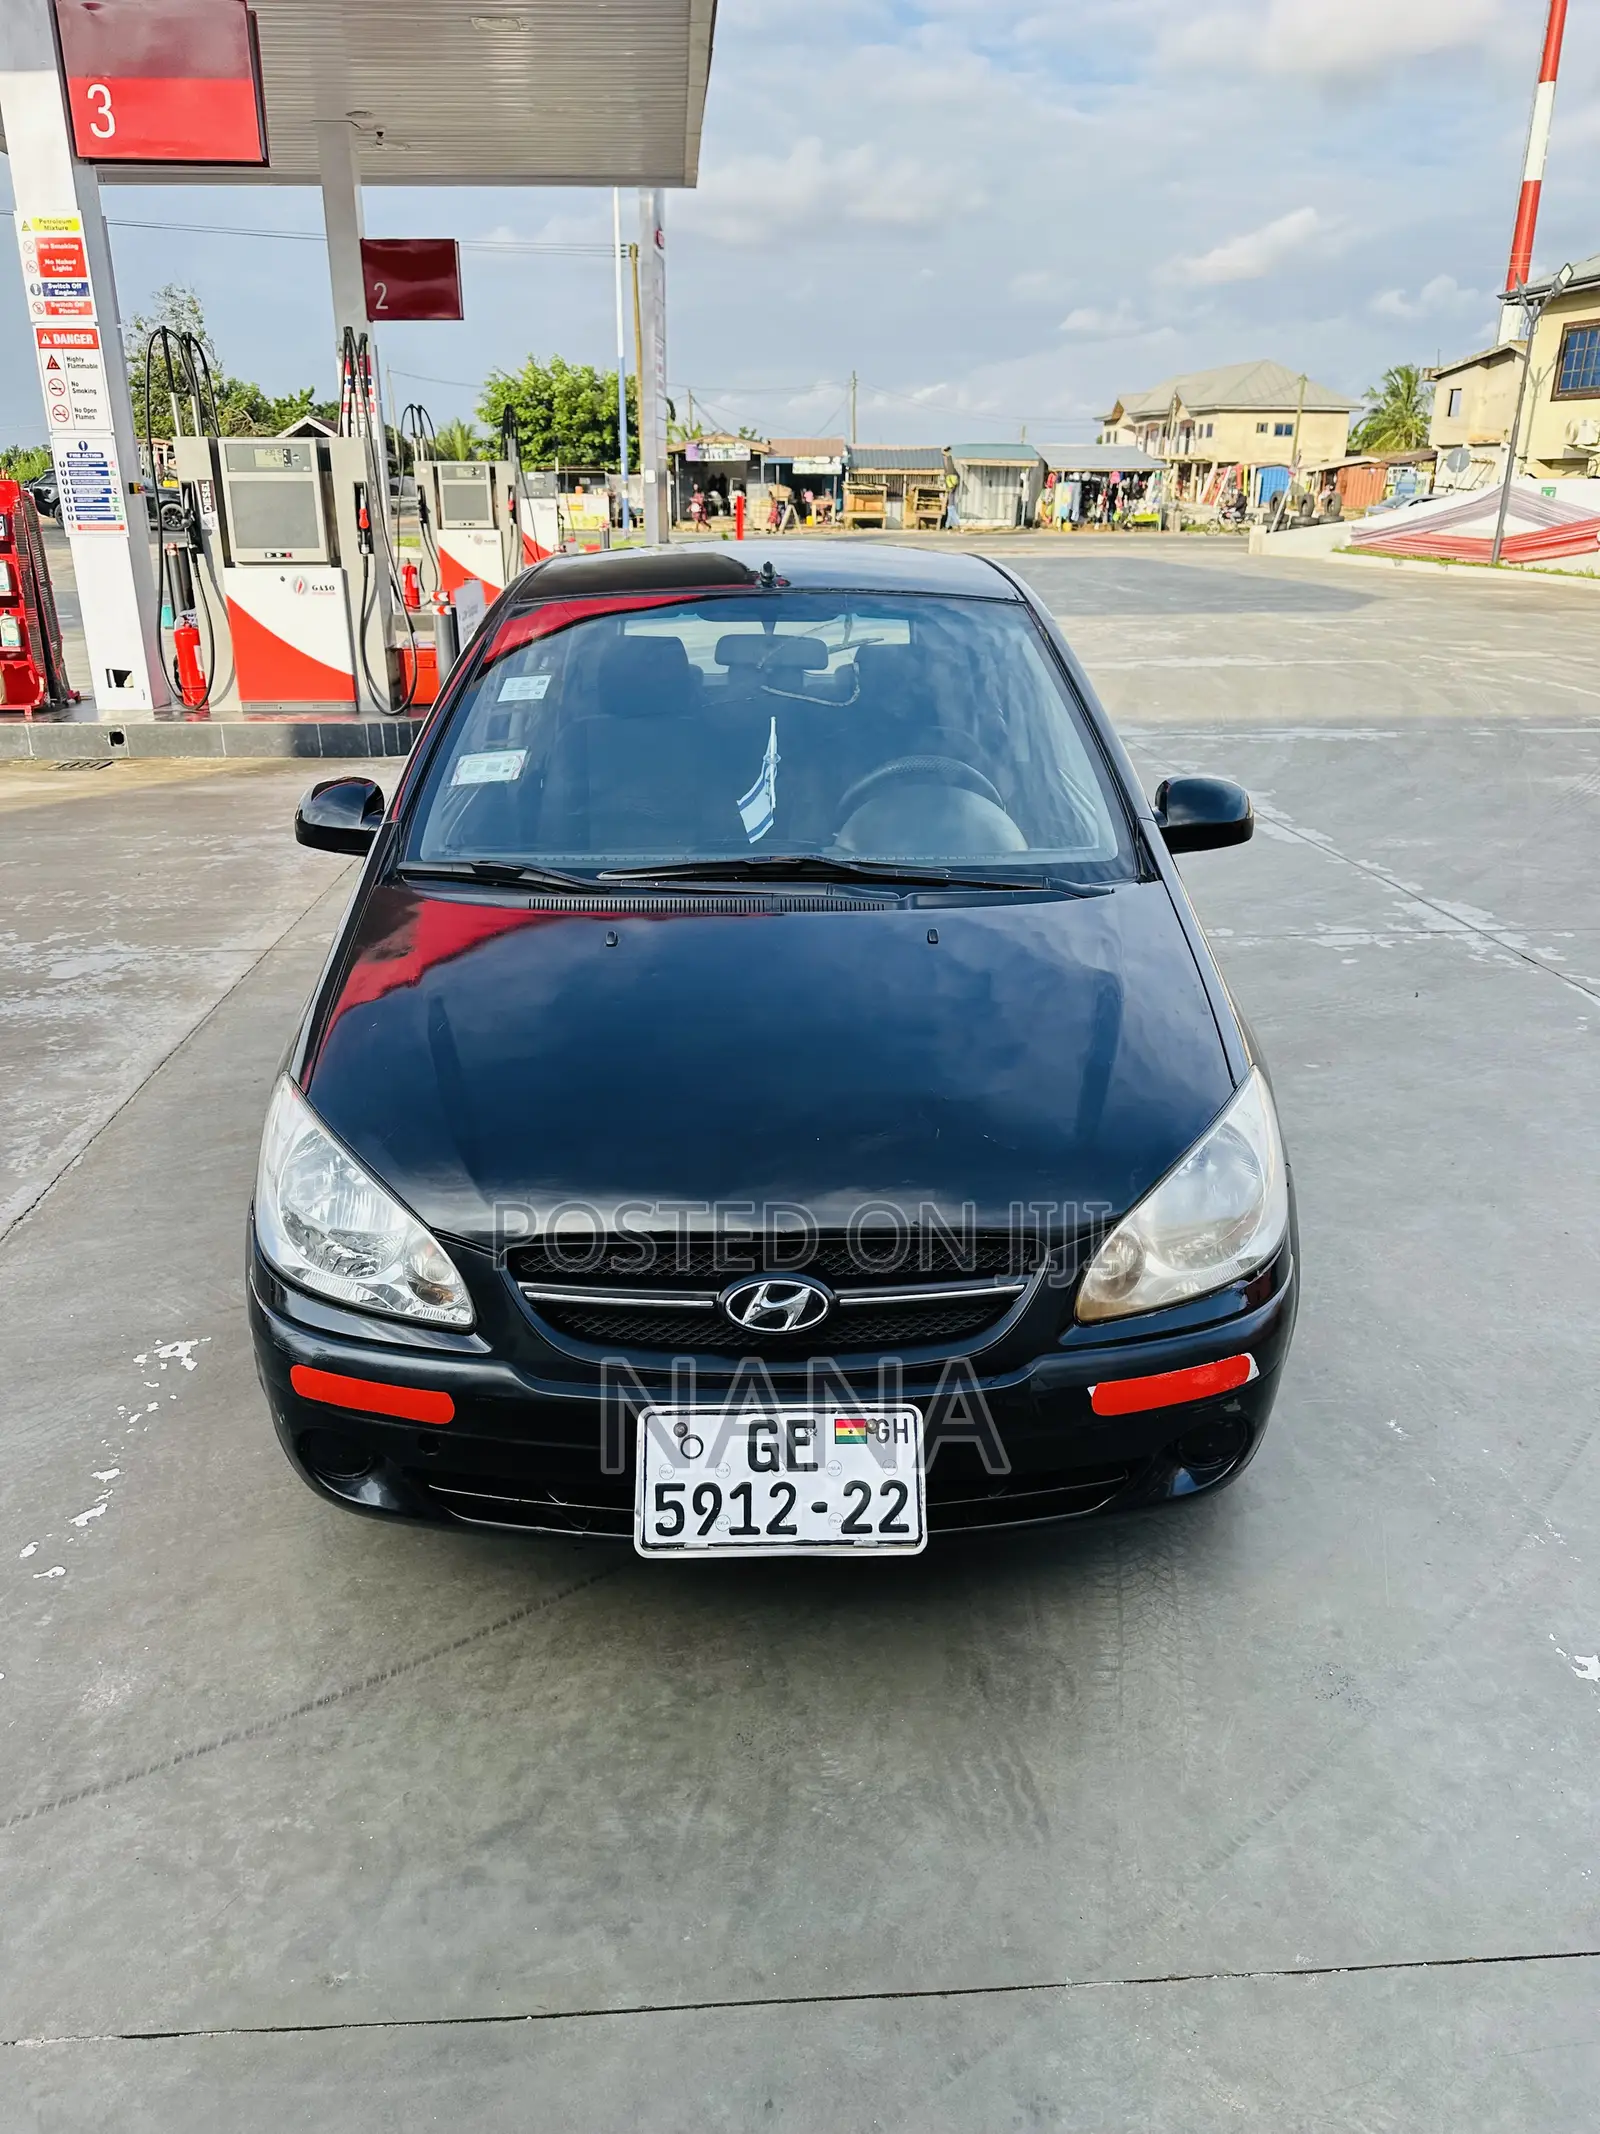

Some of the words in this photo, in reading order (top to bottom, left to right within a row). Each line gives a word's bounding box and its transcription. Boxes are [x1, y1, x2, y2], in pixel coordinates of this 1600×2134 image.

[87, 83, 116, 138] 3
[50, 243, 79, 251] Smoking
[47, 282, 71, 290] Switch
[71, 282, 82, 290] Off
[373, 282, 389, 310] 2
[53, 333, 94, 345] DANGER
[72, 387, 97, 395] Smoking
[200, 480, 213, 513] DIESEL
[747, 1419, 818, 1473] GE
[874, 1417, 908, 1444] GH
